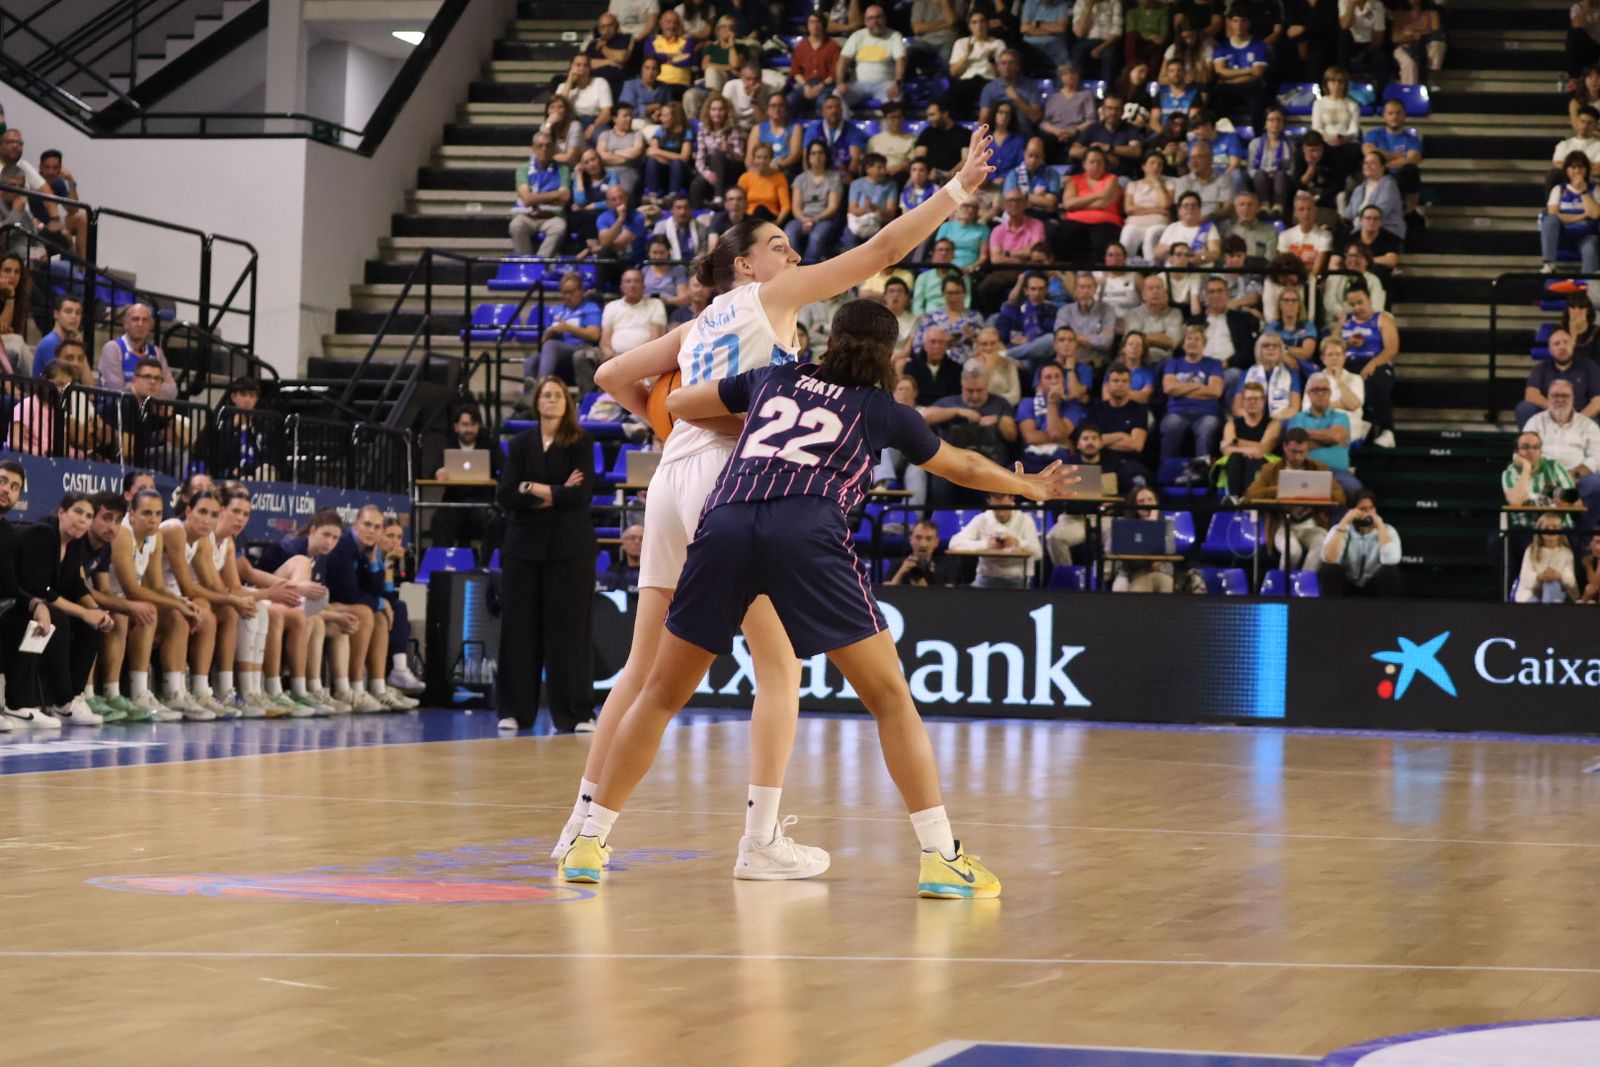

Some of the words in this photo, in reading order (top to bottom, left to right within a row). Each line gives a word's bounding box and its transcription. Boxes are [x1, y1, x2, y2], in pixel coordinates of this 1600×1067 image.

[740, 395, 844, 467] 22
[63, 472, 106, 494] CASTILLA
[250, 492, 286, 514] CASTILLA
[288, 496, 295, 516] Y
[295, 491, 316, 515] LEÓN
[593, 590, 1092, 707] xaank
[1474, 636, 1600, 686] Caixa
